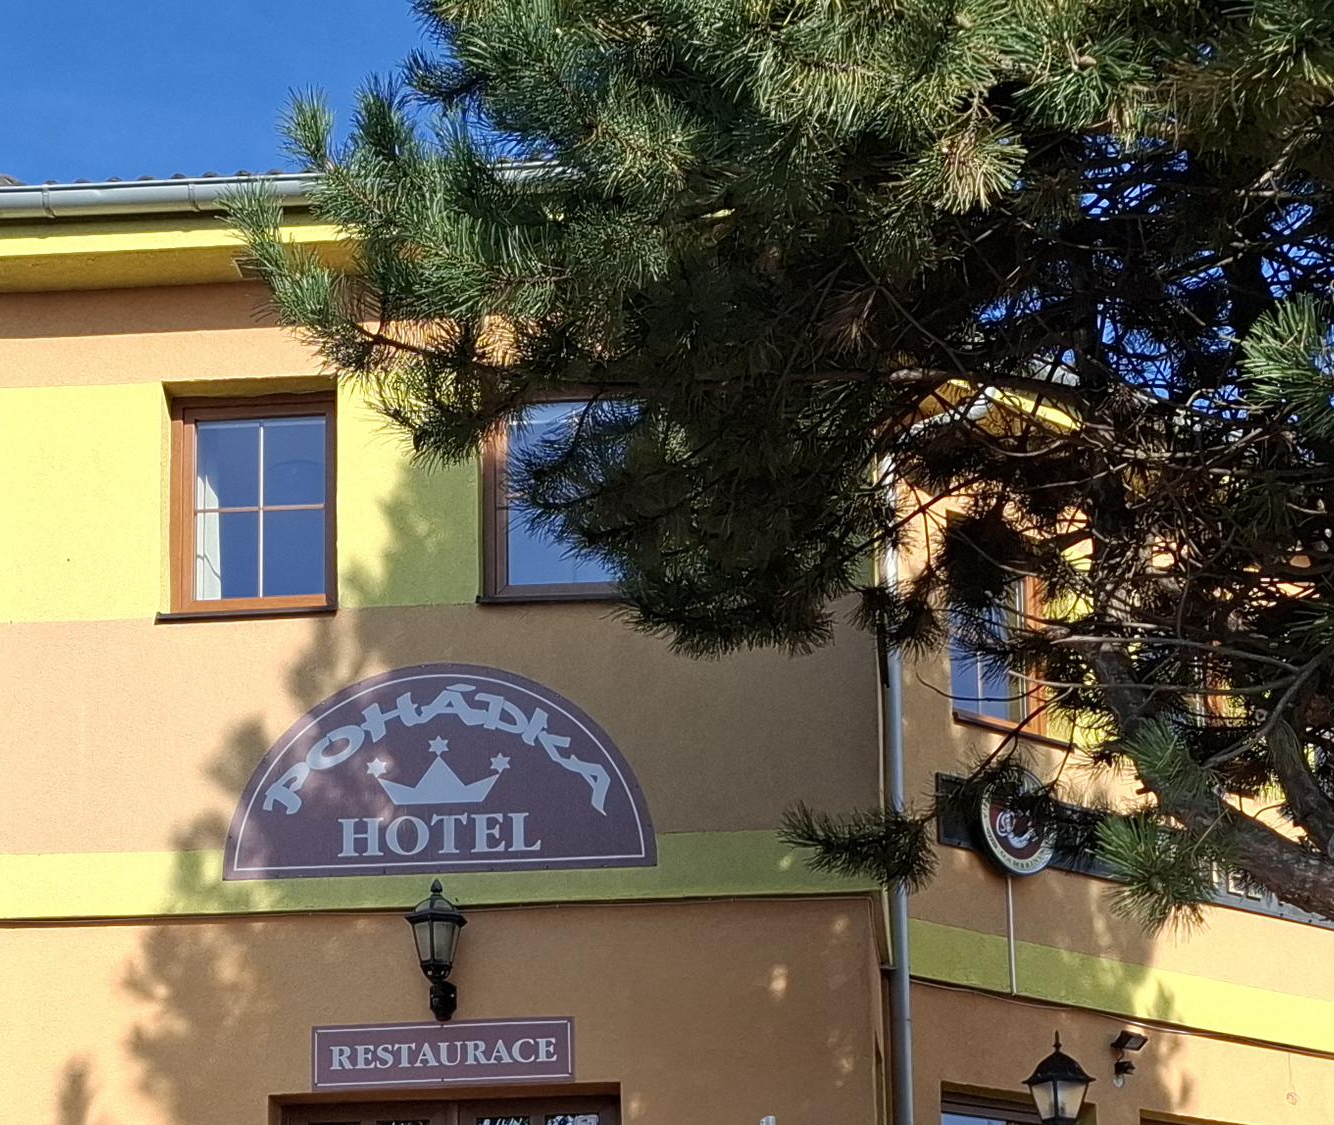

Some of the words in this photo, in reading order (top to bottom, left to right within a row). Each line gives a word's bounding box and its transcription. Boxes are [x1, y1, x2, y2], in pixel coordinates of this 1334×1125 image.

[263, 684, 611, 816] POHÁDKA
[337, 812, 542, 858] HOTEL
[329, 1037, 558, 1070] RESTAURACE
